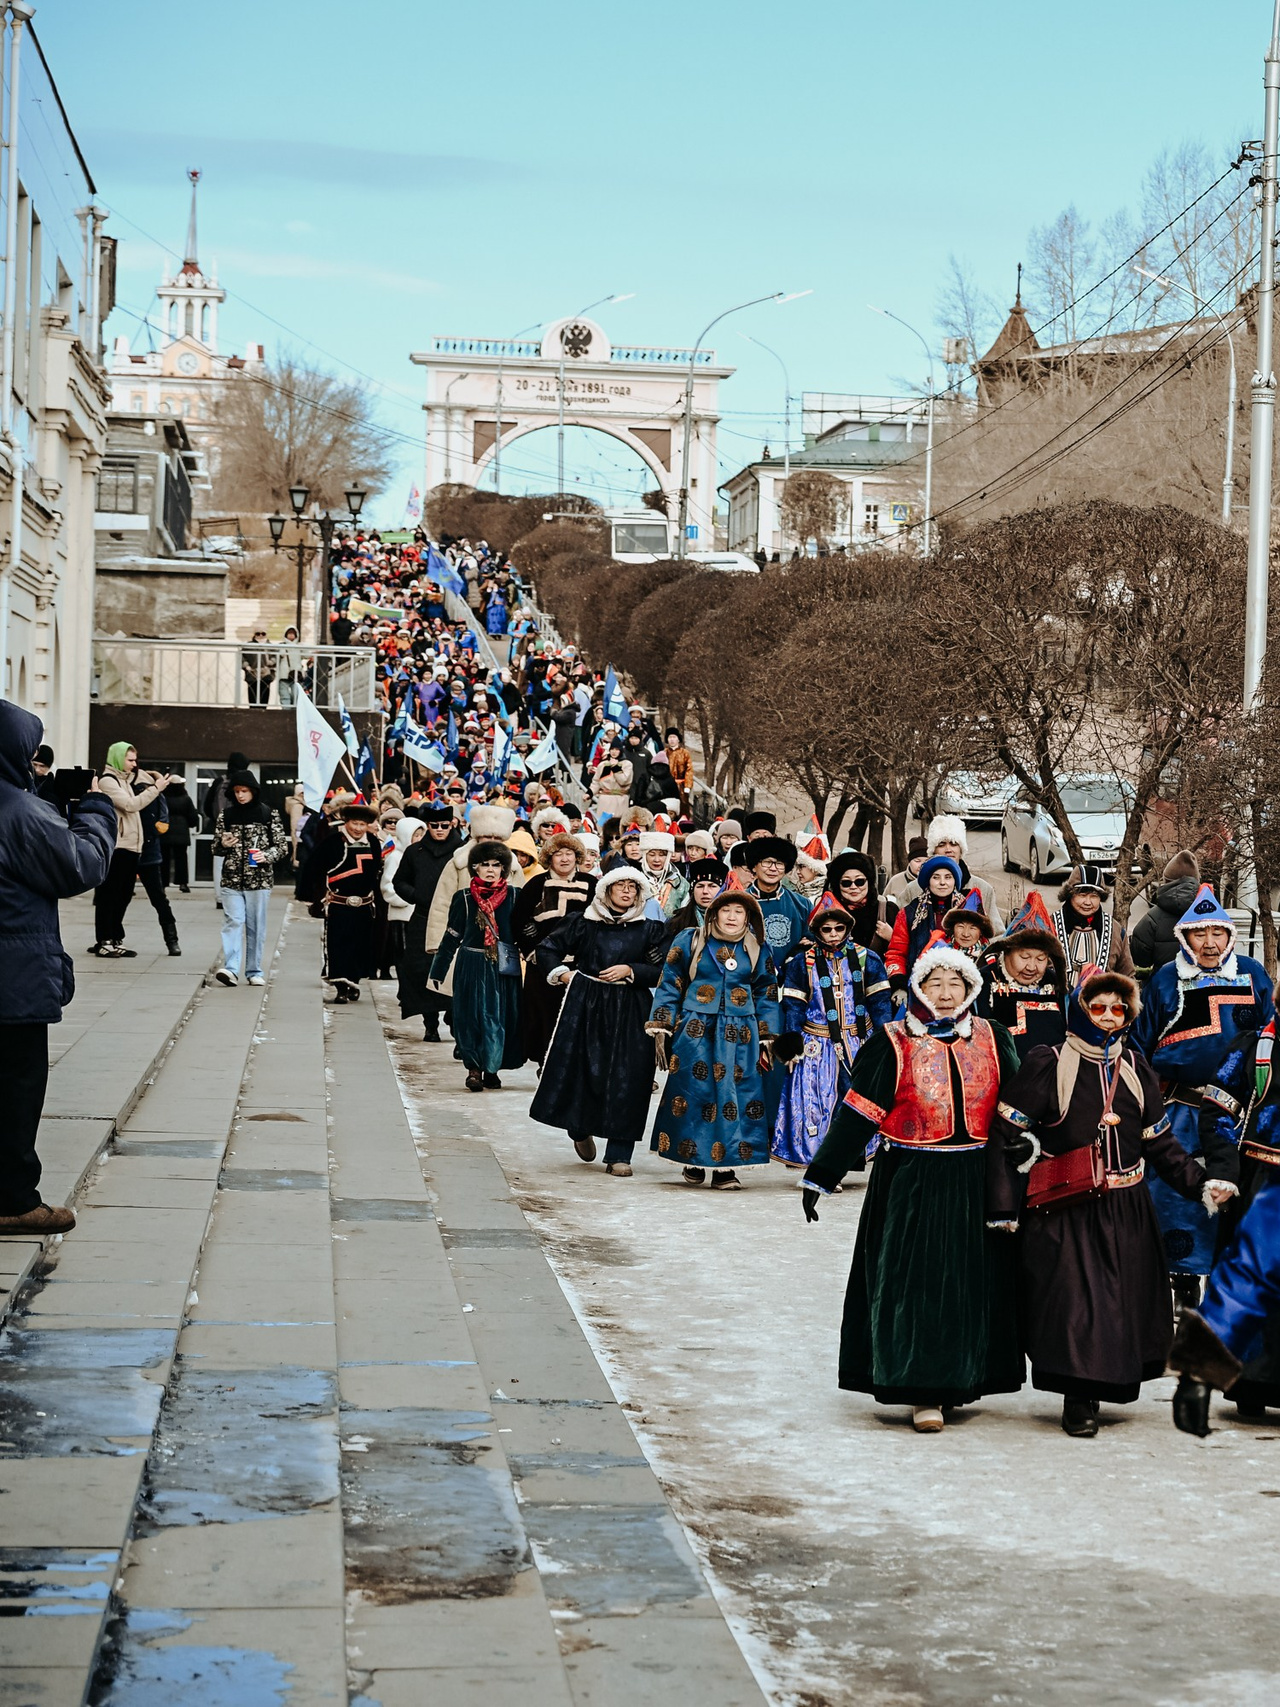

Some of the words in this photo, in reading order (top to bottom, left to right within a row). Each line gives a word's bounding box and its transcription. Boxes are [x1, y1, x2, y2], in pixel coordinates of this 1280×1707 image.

[516, 379, 529, 390] 20
[538, 380, 550, 391] 21
[582, 382, 605, 394] 1891
[609, 386, 631, 396] года
